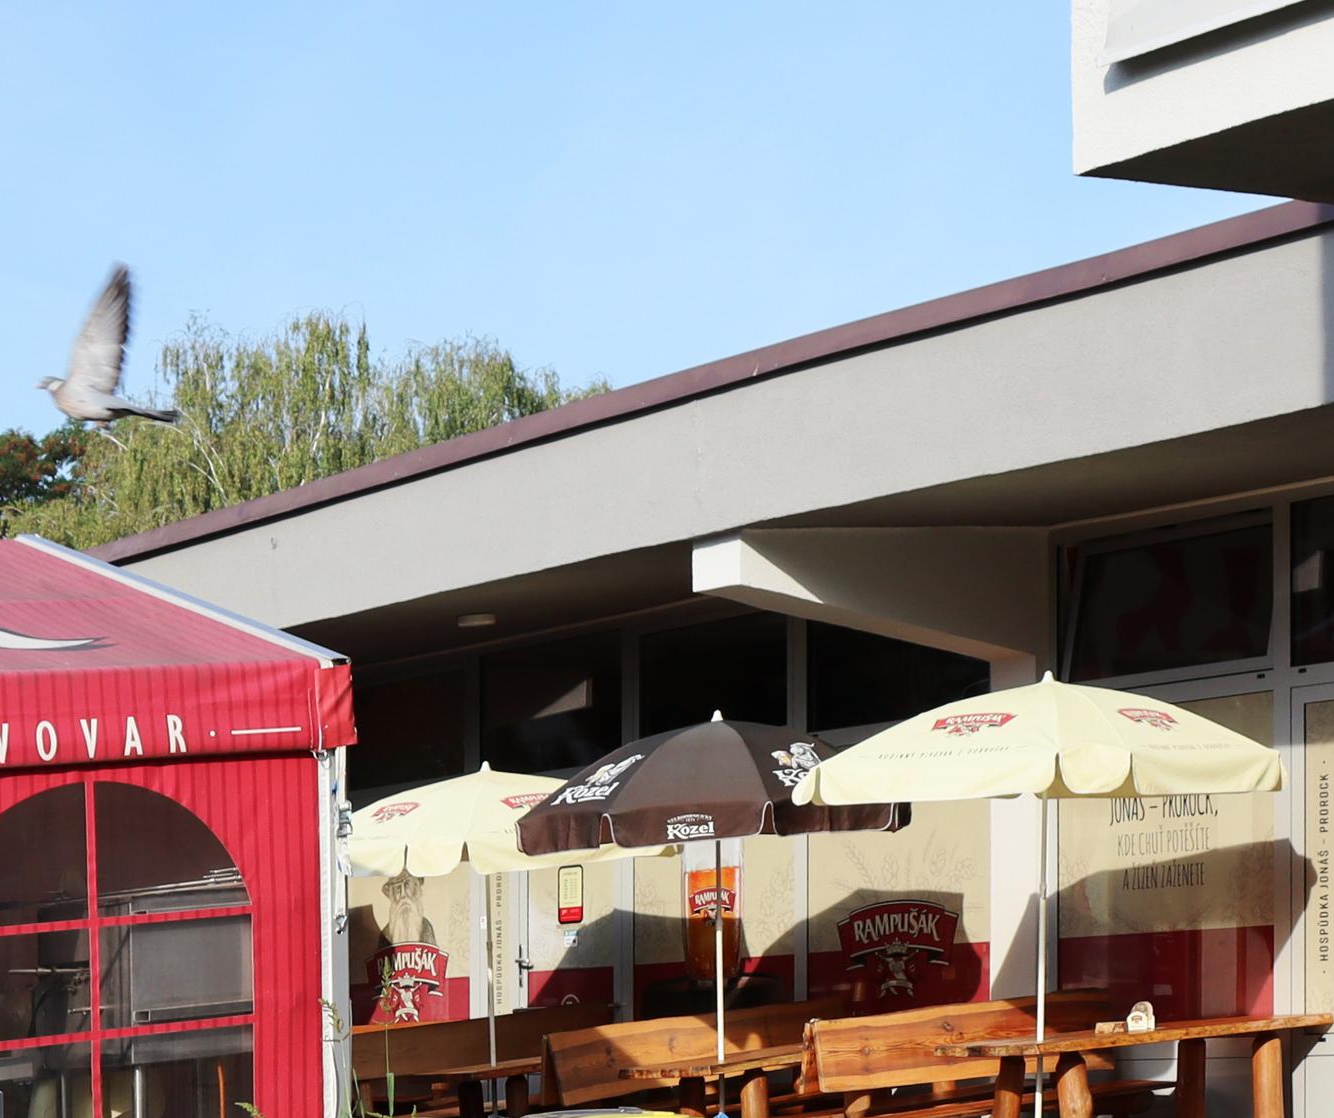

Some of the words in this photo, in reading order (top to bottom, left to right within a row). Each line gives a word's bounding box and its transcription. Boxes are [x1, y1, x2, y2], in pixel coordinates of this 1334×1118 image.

[550, 781, 619, 806] Kozel
[1319, 773, 1330, 833] PROROCK
[667, 821, 715, 840] Kozel
[1117, 832, 1135, 857] KDE
[1122, 868, 1129, 891] A
[1317, 849, 1329, 889] JONÁŠ
[853, 908, 941, 944] RAMPUŠÁK
[1317, 894, 1329, 962] HOSPŮDKA
